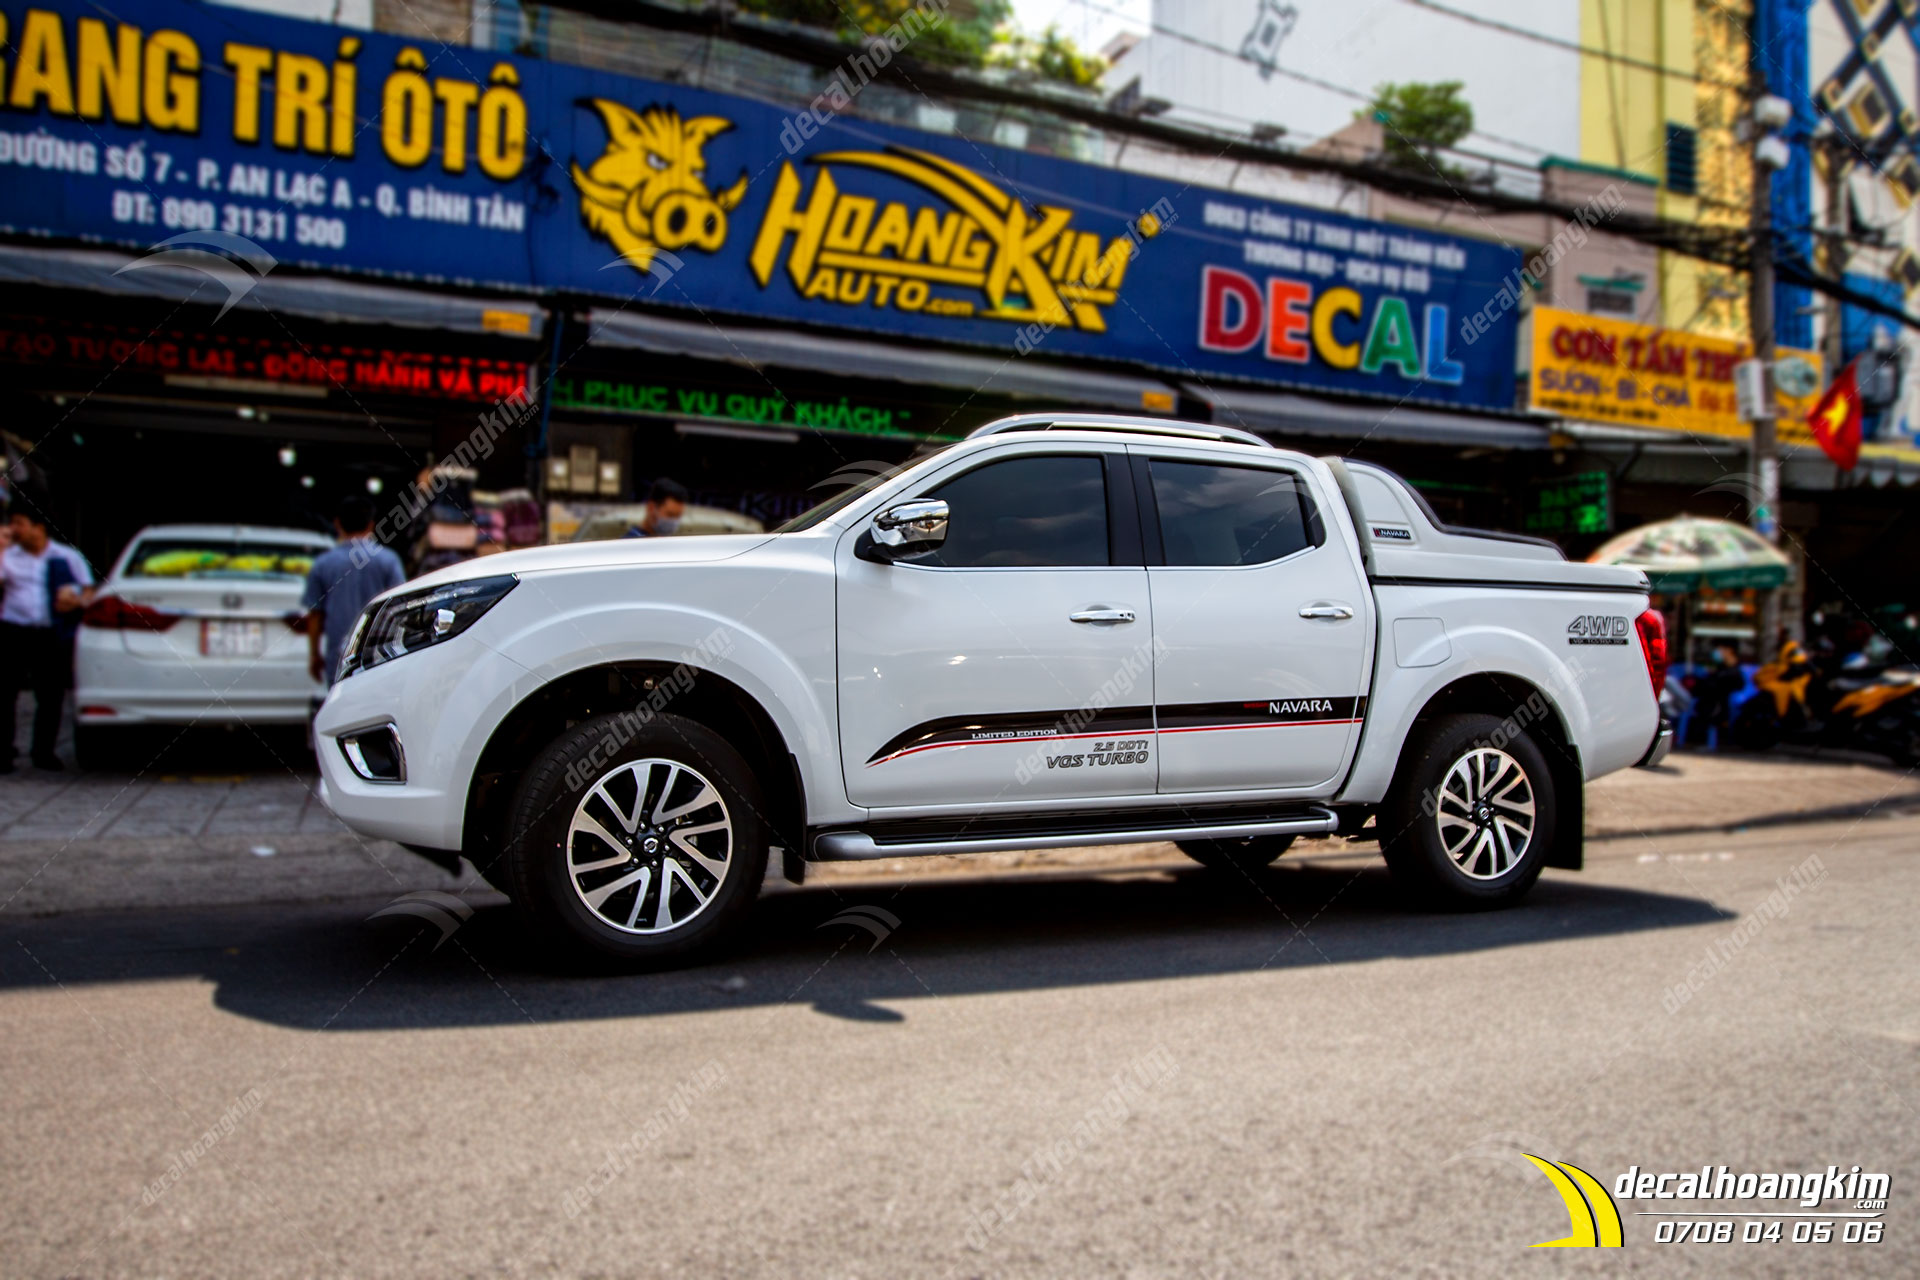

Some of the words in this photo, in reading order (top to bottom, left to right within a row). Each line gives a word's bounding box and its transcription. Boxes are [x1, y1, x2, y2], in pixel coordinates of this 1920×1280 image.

[0, 9, 201, 133] ANG
[224, 38, 360, 157] TRÍ
[382, 48, 528, 179] ÔTÔ
[105, 139, 147, 180] SỐ
[152, 152, 172, 183] 7
[227, 162, 269, 198] AN
[274, 170, 327, 208] LẠC
[332, 177, 351, 209] A
[407, 182, 471, 225] BÌNH
[475, 192, 526, 232] TÂN
[161, 196, 217, 231] 090
[222, 203, 287, 242] 3131
[295, 213, 346, 249] 500
[1200, 265, 1464, 385] DECAL
[1567, 615, 1630, 637] 4WD
[1269, 700, 1333, 714] NAVARA
[971, 731, 1016, 740] LIMITED
[1016, 728, 1058, 737] EDITION
[1046, 754, 1084, 769] VGS
[1087, 751, 1149, 767] TURBO
